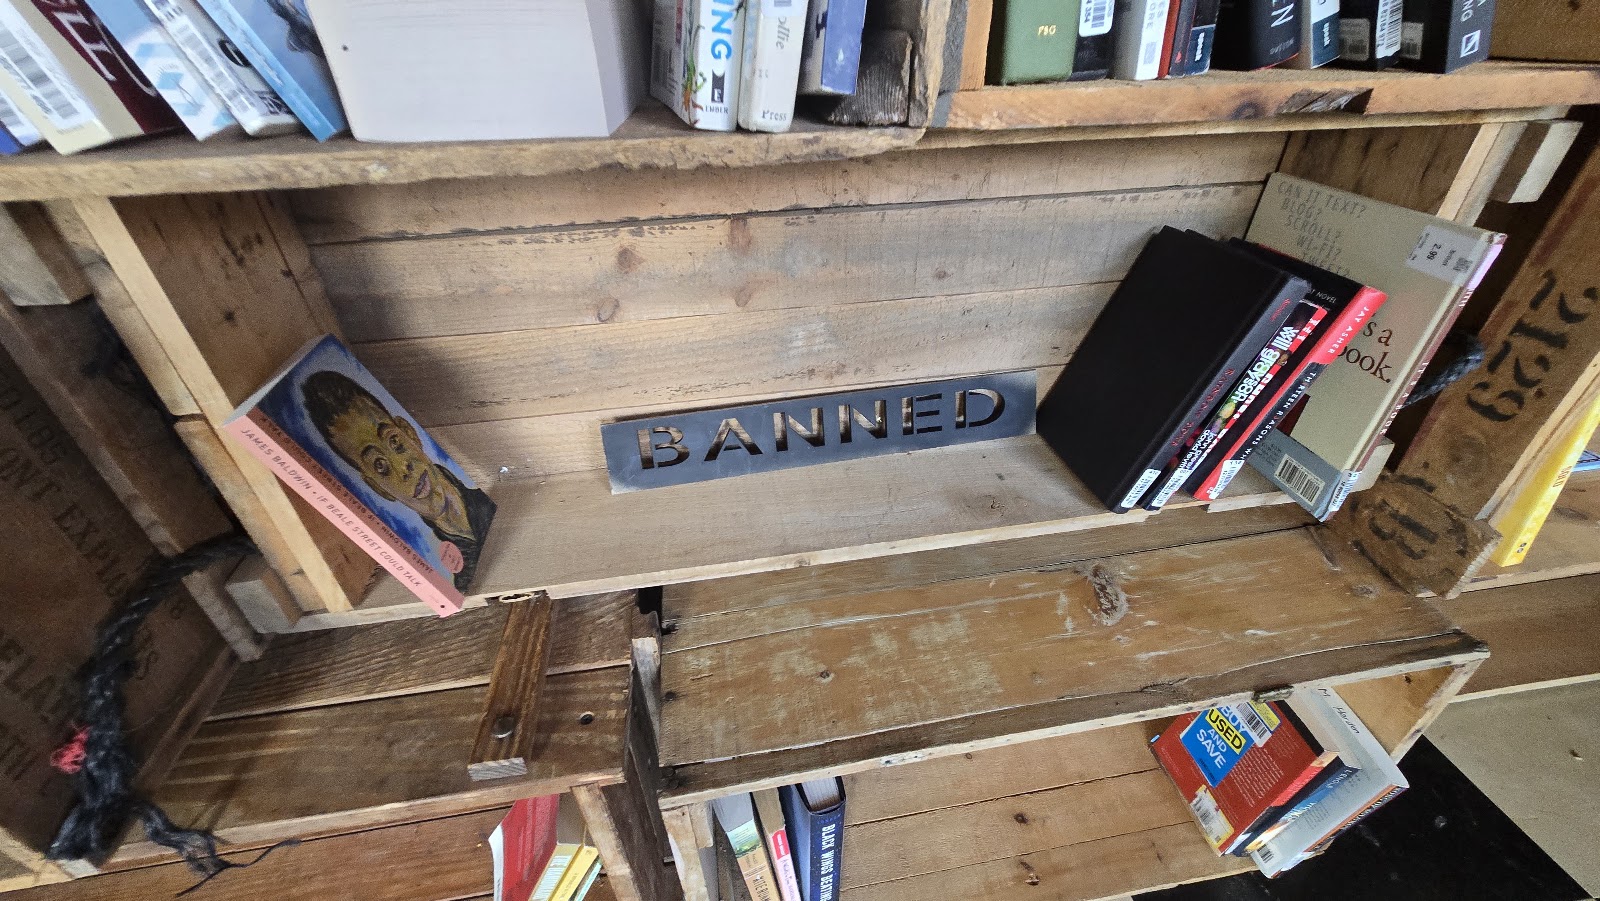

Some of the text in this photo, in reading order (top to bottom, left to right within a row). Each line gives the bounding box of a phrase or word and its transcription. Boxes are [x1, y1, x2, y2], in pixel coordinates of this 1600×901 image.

[1281, 197, 1323, 222] BLOG?
[1325, 194, 1367, 219] TEXT?
[1284, 214, 1342, 241] SCROLL?
[1427, 243, 1442, 261] 2.99
[1315, 291, 1338, 304] NOVEL
[1327, 306, 1370, 355] JAY ASHER
[1377, 328, 1393, 347] a
[1338, 346, 1393, 384] ook.
[636, 388, 1006, 471] BANNED
[240, 429, 274, 456] JAMES
[271, 455, 312, 490] BALDWIN
[326, 503, 353, 527] BEALE
[351, 525, 381, 552] STREET
[379, 550, 404, 572] COULD
[402, 570, 422, 587] TALK
[381, 525, 413, 557] BALDWIN
[1208, 708, 1243, 750] USED
[1219, 704, 1248, 733] BUY
[1196, 728, 1227, 769] SAVE
[1207, 728, 1228, 753] AND
[821, 823, 836, 851] BLACK
[820, 850, 835, 875] WINGS
